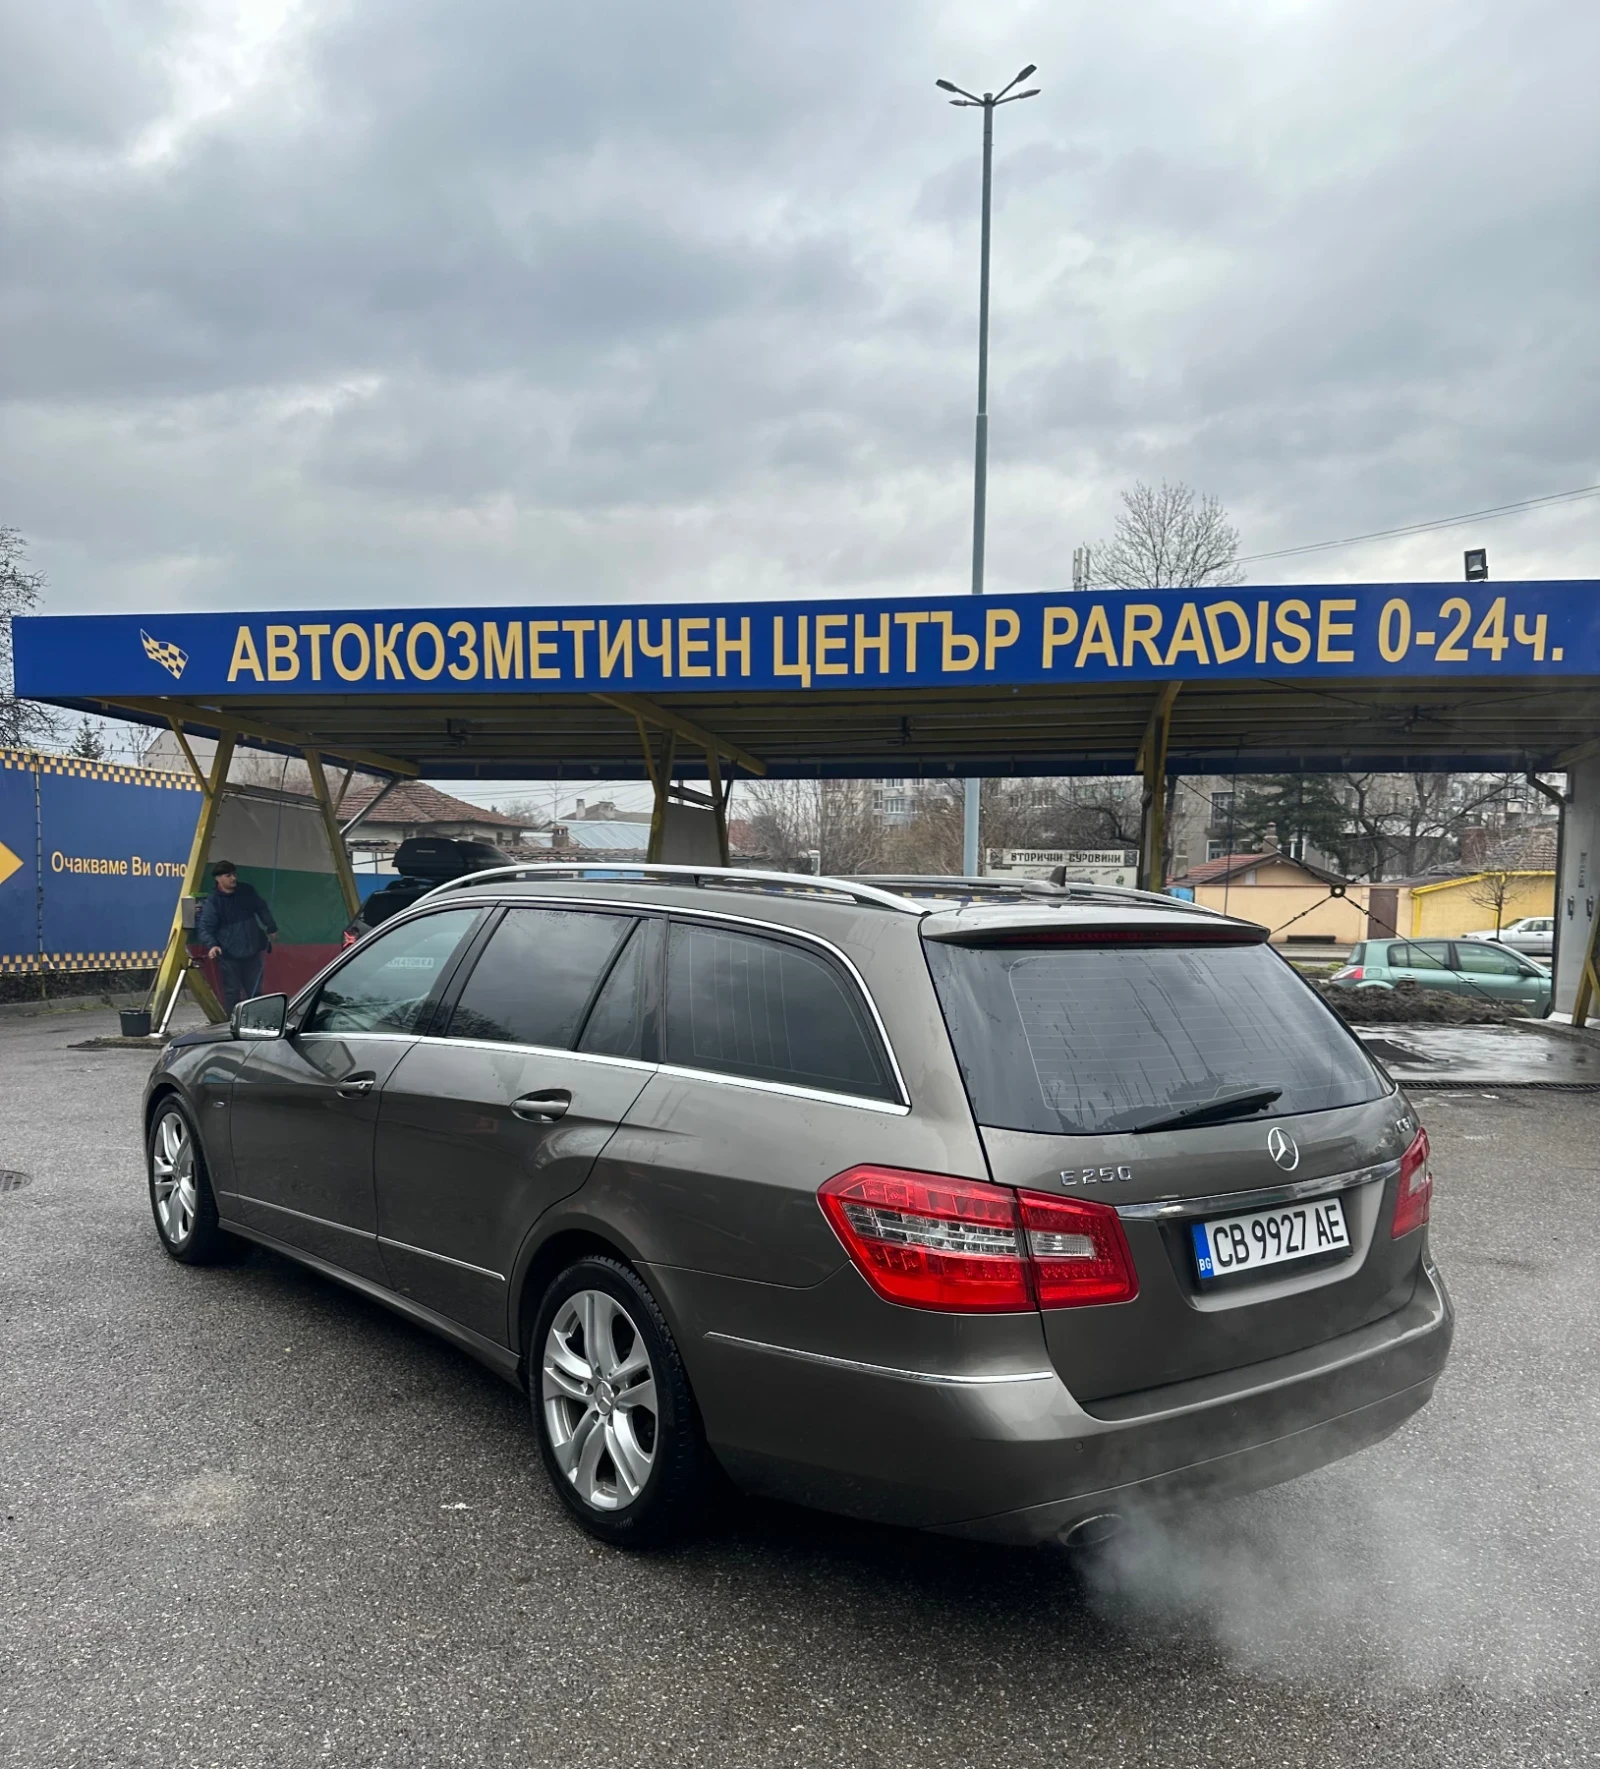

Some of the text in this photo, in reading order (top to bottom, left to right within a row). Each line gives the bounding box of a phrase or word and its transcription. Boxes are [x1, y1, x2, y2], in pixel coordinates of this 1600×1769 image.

[226, 597, 1564, 688] АВТОКОЗМЕТИЧЕН ЦЕНТЪР PARADISE 0-24ч.
[51, 851, 128, 876] Очакваме
[132, 856, 151, 877] Ви
[1011, 852, 1121, 864] ВТОРИЧНИ СУРОВИНИ
[1060, 1166, 1132, 1186] E 250
[1213, 1204, 1345, 1268] CB 9927 AE
[1198, 1257, 1212, 1271] BG
